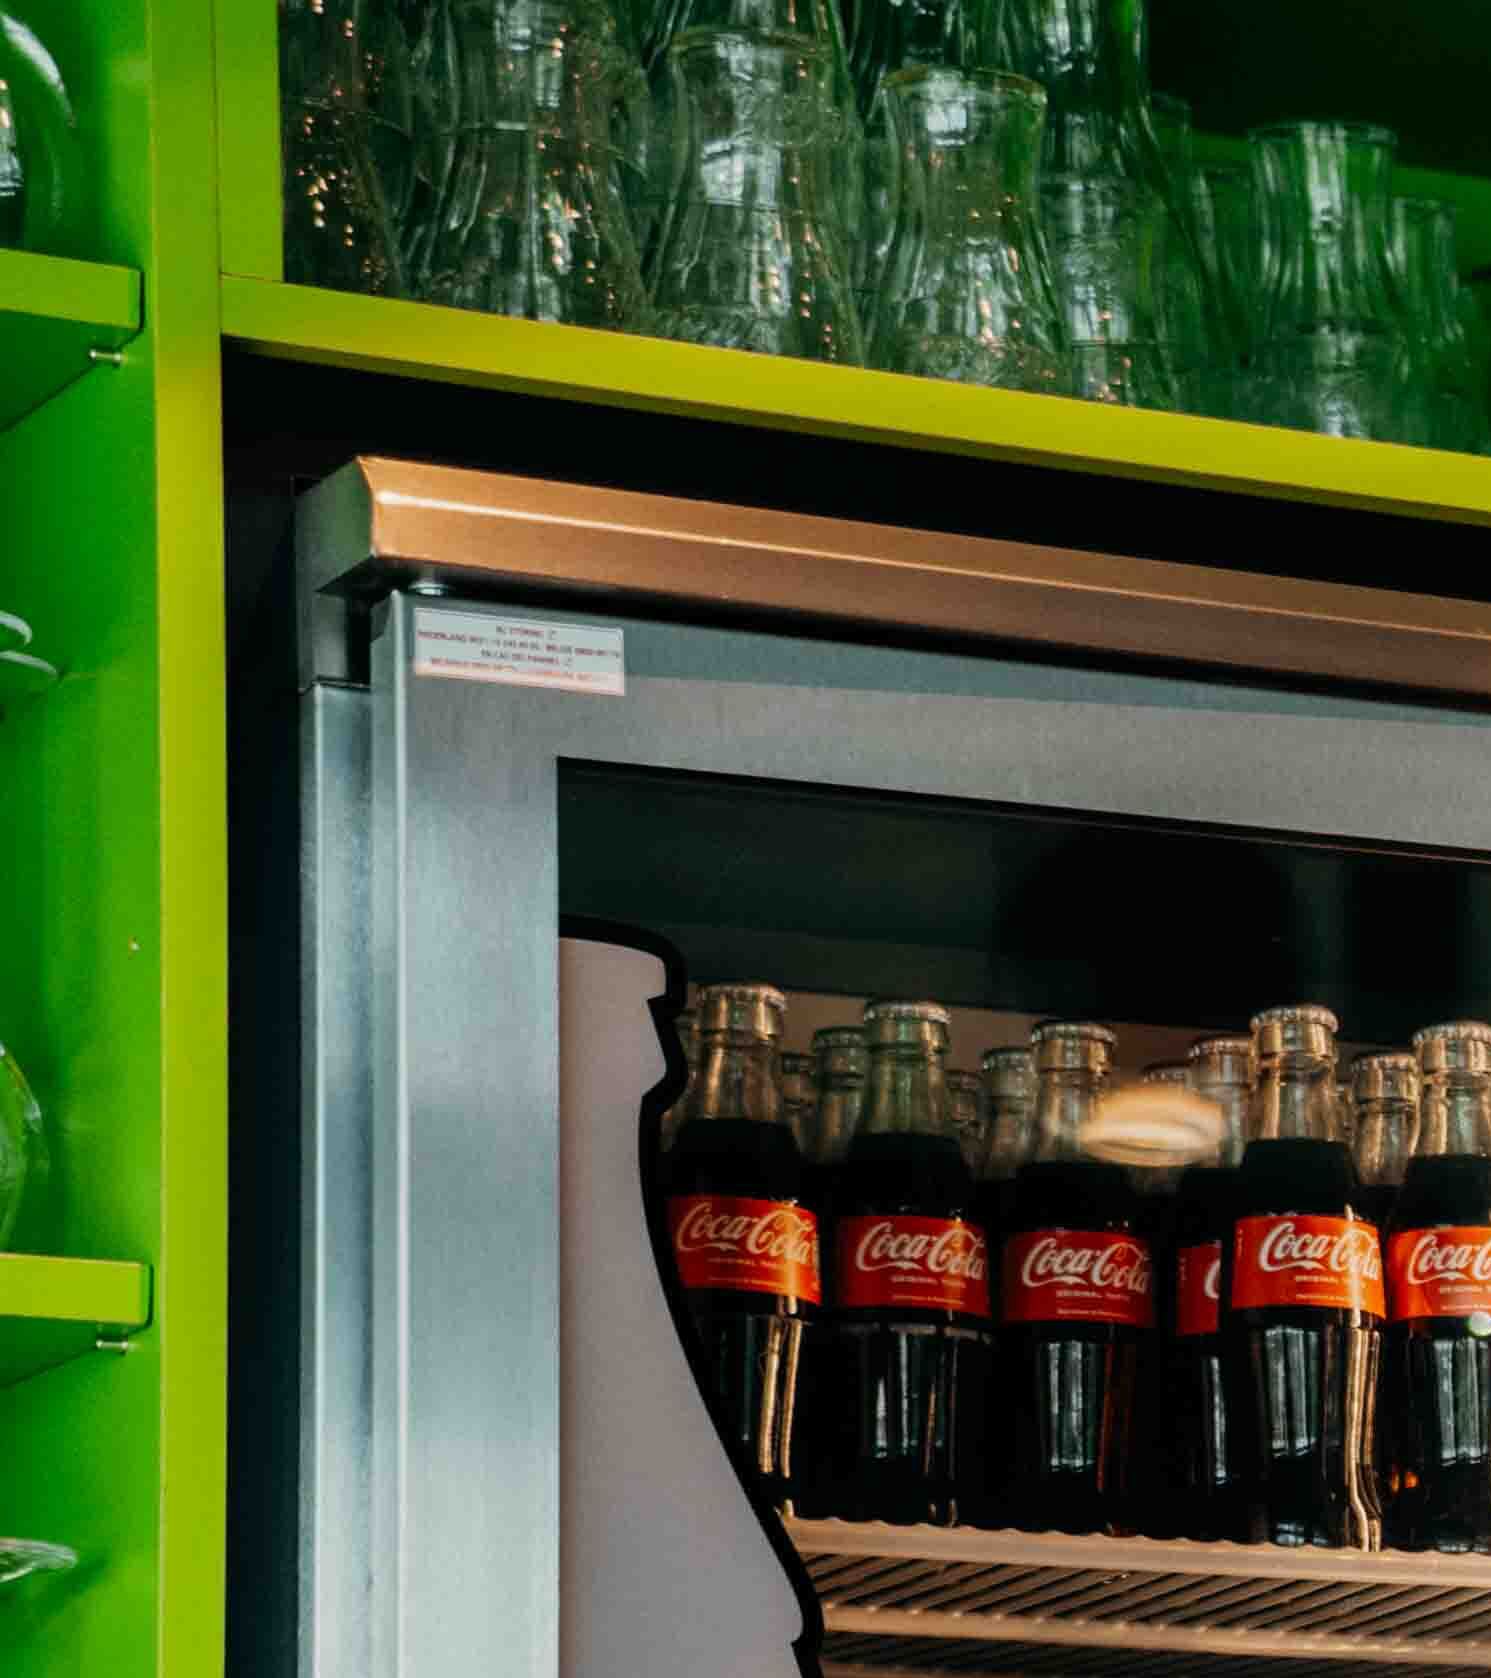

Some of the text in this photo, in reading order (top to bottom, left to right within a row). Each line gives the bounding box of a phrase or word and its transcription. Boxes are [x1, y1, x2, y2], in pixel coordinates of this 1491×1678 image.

[676, 1202, 815, 1265] Coca-Cola
[856, 1221, 986, 1280] Coca-Cola
[1021, 1237, 1149, 1294] Coca-Cola
